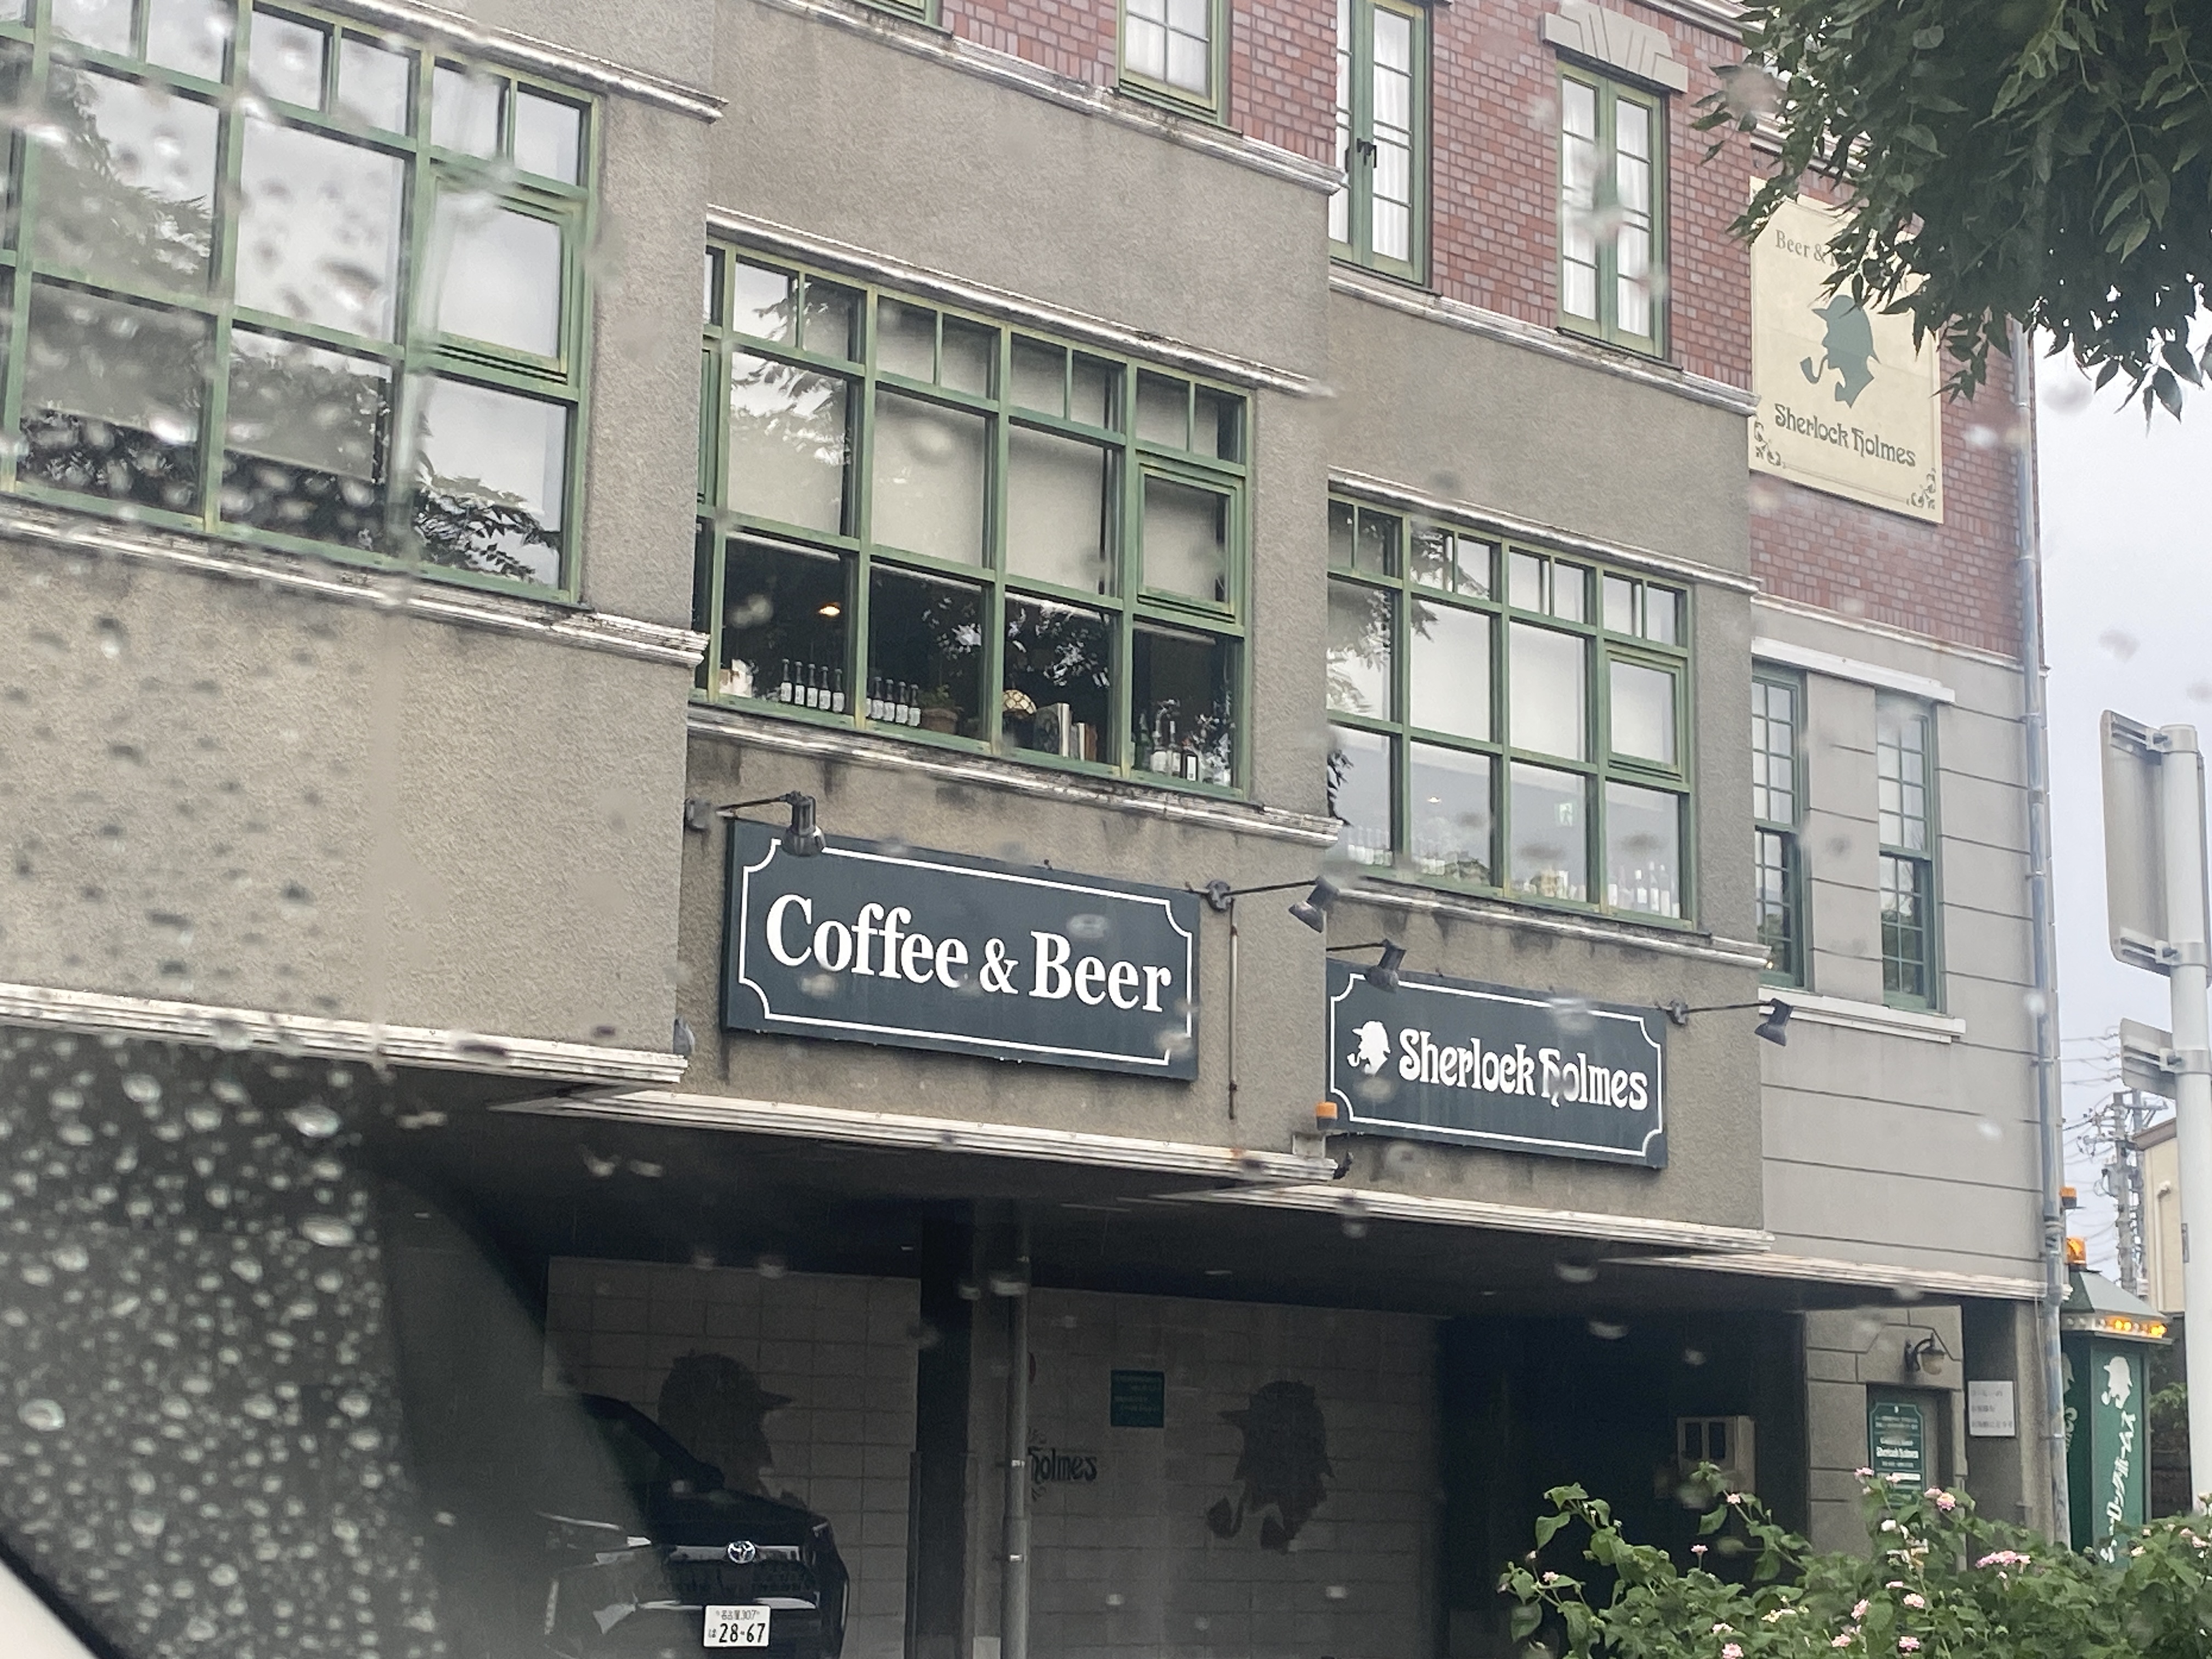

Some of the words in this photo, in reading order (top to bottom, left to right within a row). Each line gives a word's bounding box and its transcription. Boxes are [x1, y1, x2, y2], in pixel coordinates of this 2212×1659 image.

[1775, 229, 1809, 258] Beer
[1814, 244, 1826, 264] &
[1774, 403, 1849, 449] Sherlock
[766, 894, 969, 988] Coffee
[979, 938, 1019, 994] &
[1029, 931, 1172, 1012] Beer
[1399, 1028, 1536, 1097] Sherlock
[719, 1623, 765, 1643] 28-67
